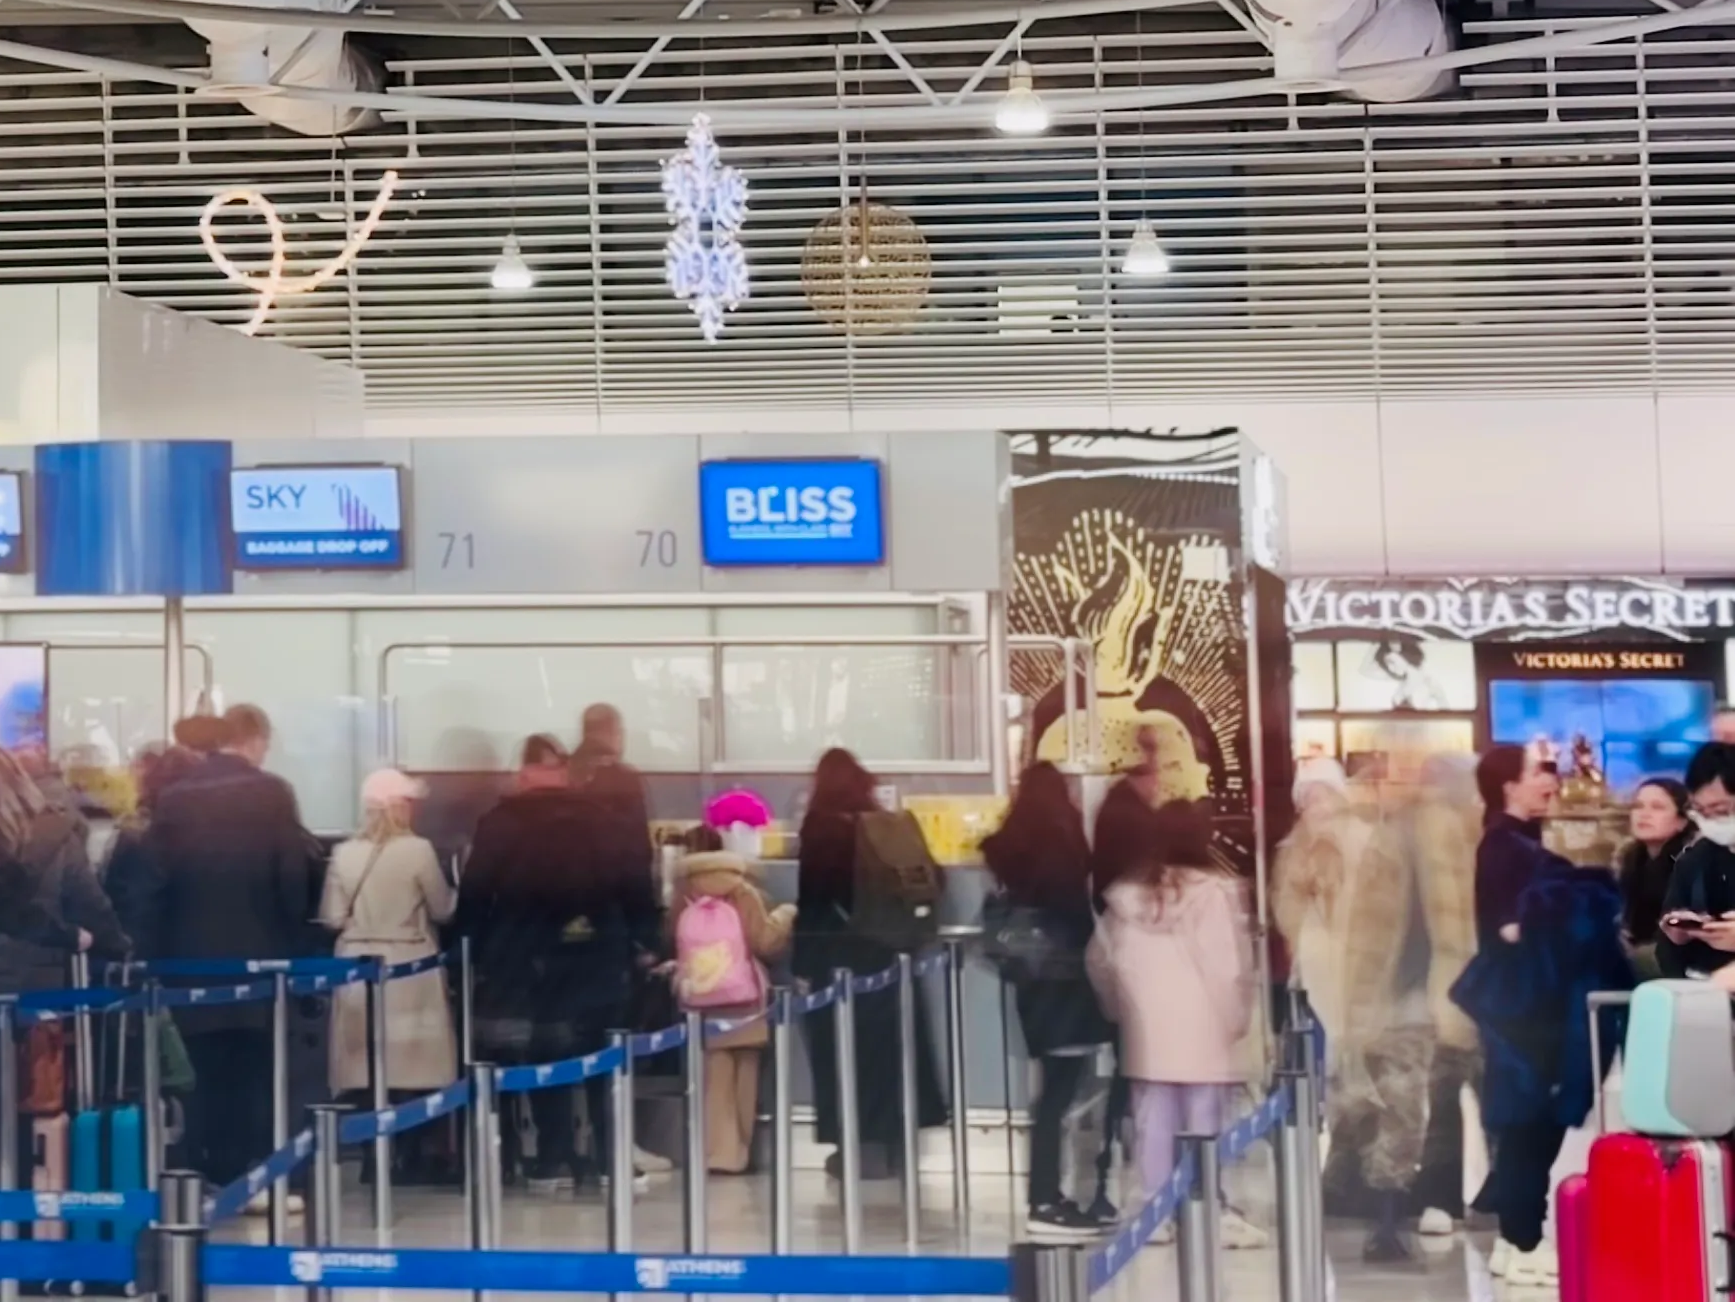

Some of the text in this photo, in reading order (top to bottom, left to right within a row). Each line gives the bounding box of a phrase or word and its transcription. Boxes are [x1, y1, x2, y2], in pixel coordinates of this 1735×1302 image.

[246, 483, 307, 509] SKY
[725, 485, 858, 523] BLISS
[317, 539, 357, 554] DROP
[358, 538, 389, 553] OFF
[437, 532, 475, 570] 71
[635, 529, 678, 567] 70
[1512, 651, 1685, 670] VICTORIA'S SECRET
[61, 1192, 126, 1206] ATHENS
[320, 1253, 398, 1268] ATHENS
[666, 1259, 747, 1274] ATHENS
